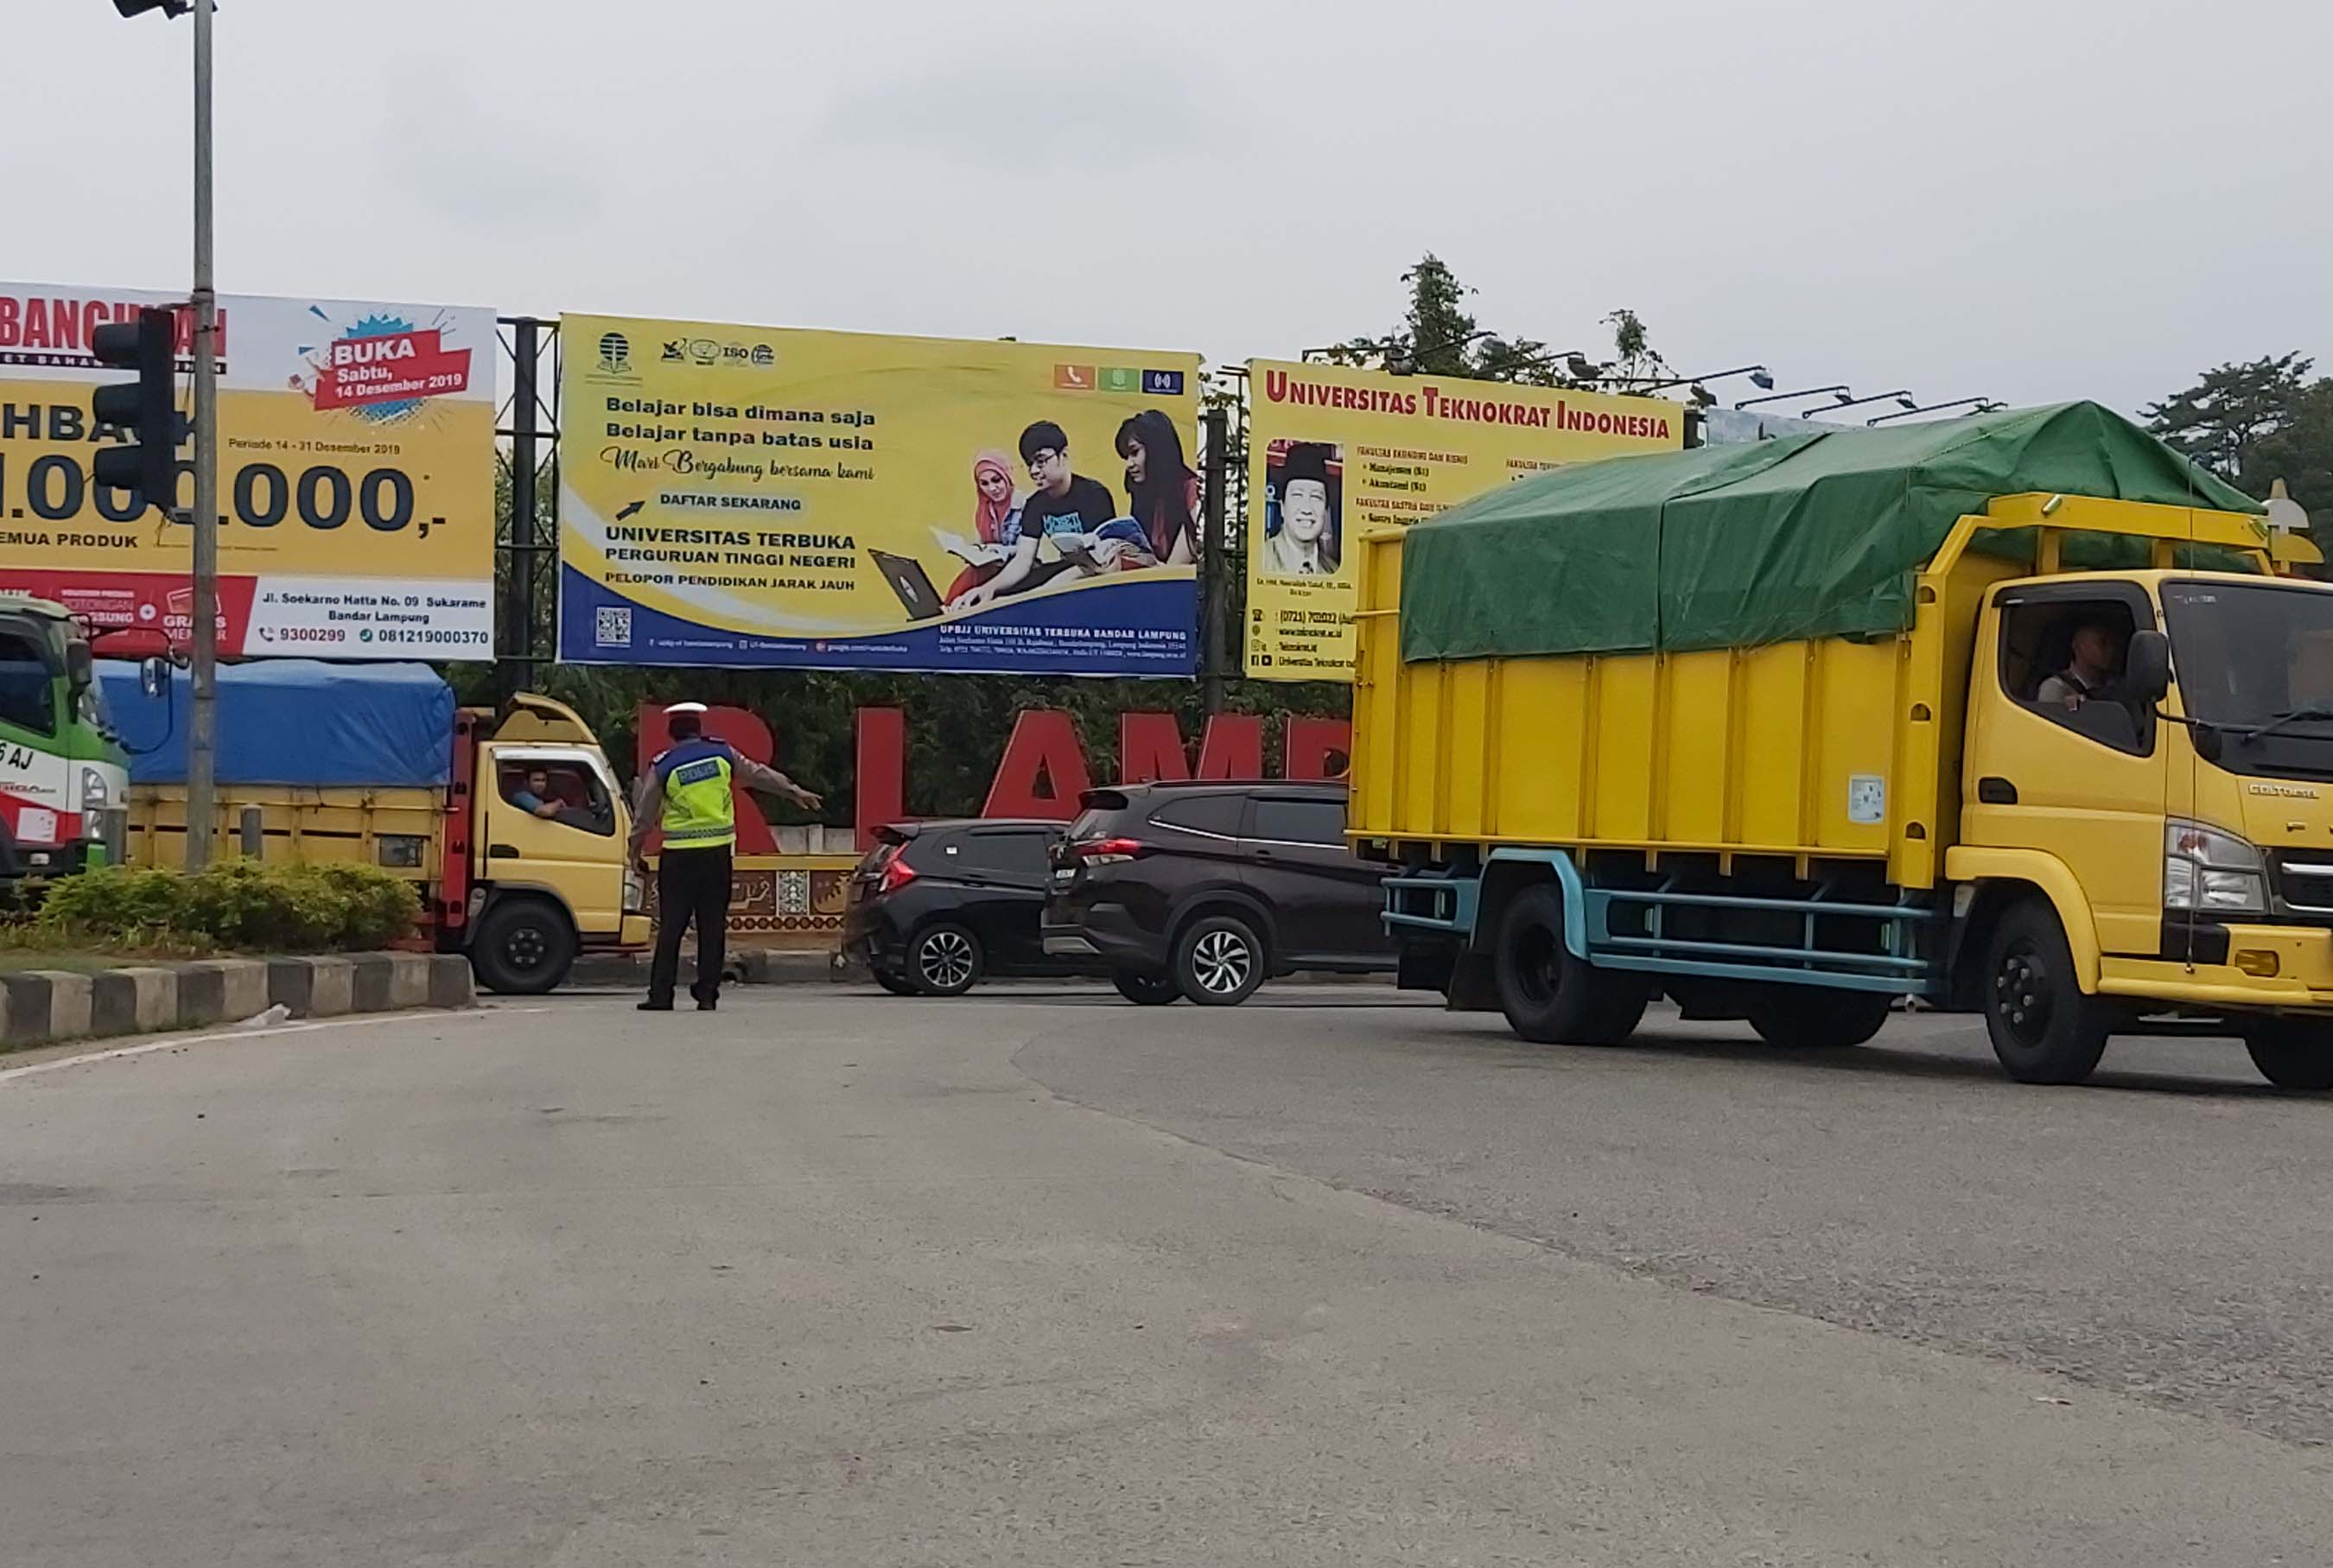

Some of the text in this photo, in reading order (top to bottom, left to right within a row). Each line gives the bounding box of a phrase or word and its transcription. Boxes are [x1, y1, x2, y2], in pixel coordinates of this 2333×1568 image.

[334, 338, 416, 365] BUKA
[335, 373, 463, 398] 14 Desember 2019
[337, 366, 393, 384] Sabtu,
[606, 397, 876, 429] Belajar bisa dimana saja
[1265, 370, 1670, 440] UNIVERSITAS TEKNOKRAT INDONESIA
[276, 440, 289, 450] 14
[315, 441, 371, 454] Desember
[606, 422, 874, 452] Belajar tanpa batas usia
[662, 448, 764, 483] Bergabung
[770, 459, 831, 479] bersama
[837, 462, 875, 481] kami
[0, 451, 445, 539] .00.000,-
[660, 493, 802, 511] DAFTAR SEKARANG
[57, 533, 138, 549] PRODUK
[605, 525, 856, 550] UNIVERSITAS TERBUKA
[605, 548, 856, 569] PERGURUAN TINGGI NEGERI
[605, 571, 855, 591] PELOPOR PENDIDIKAN JARAK JAUH
[262, 592, 486, 609] Jl. Soekarno Hatta No. 09 Sukarame
[328, 610, 429, 625] Bandar Lampung
[280, 628, 489, 644] 9300299 081219000370
[974, 625, 1042, 637] UNIVERSITAS
[1045, 628, 1090, 638] TERBUKA
[1093, 629, 1135, 639] BANDAR
[1137, 630, 1186, 640] LAMPUNG
[8, 747, 34, 771] AJ
